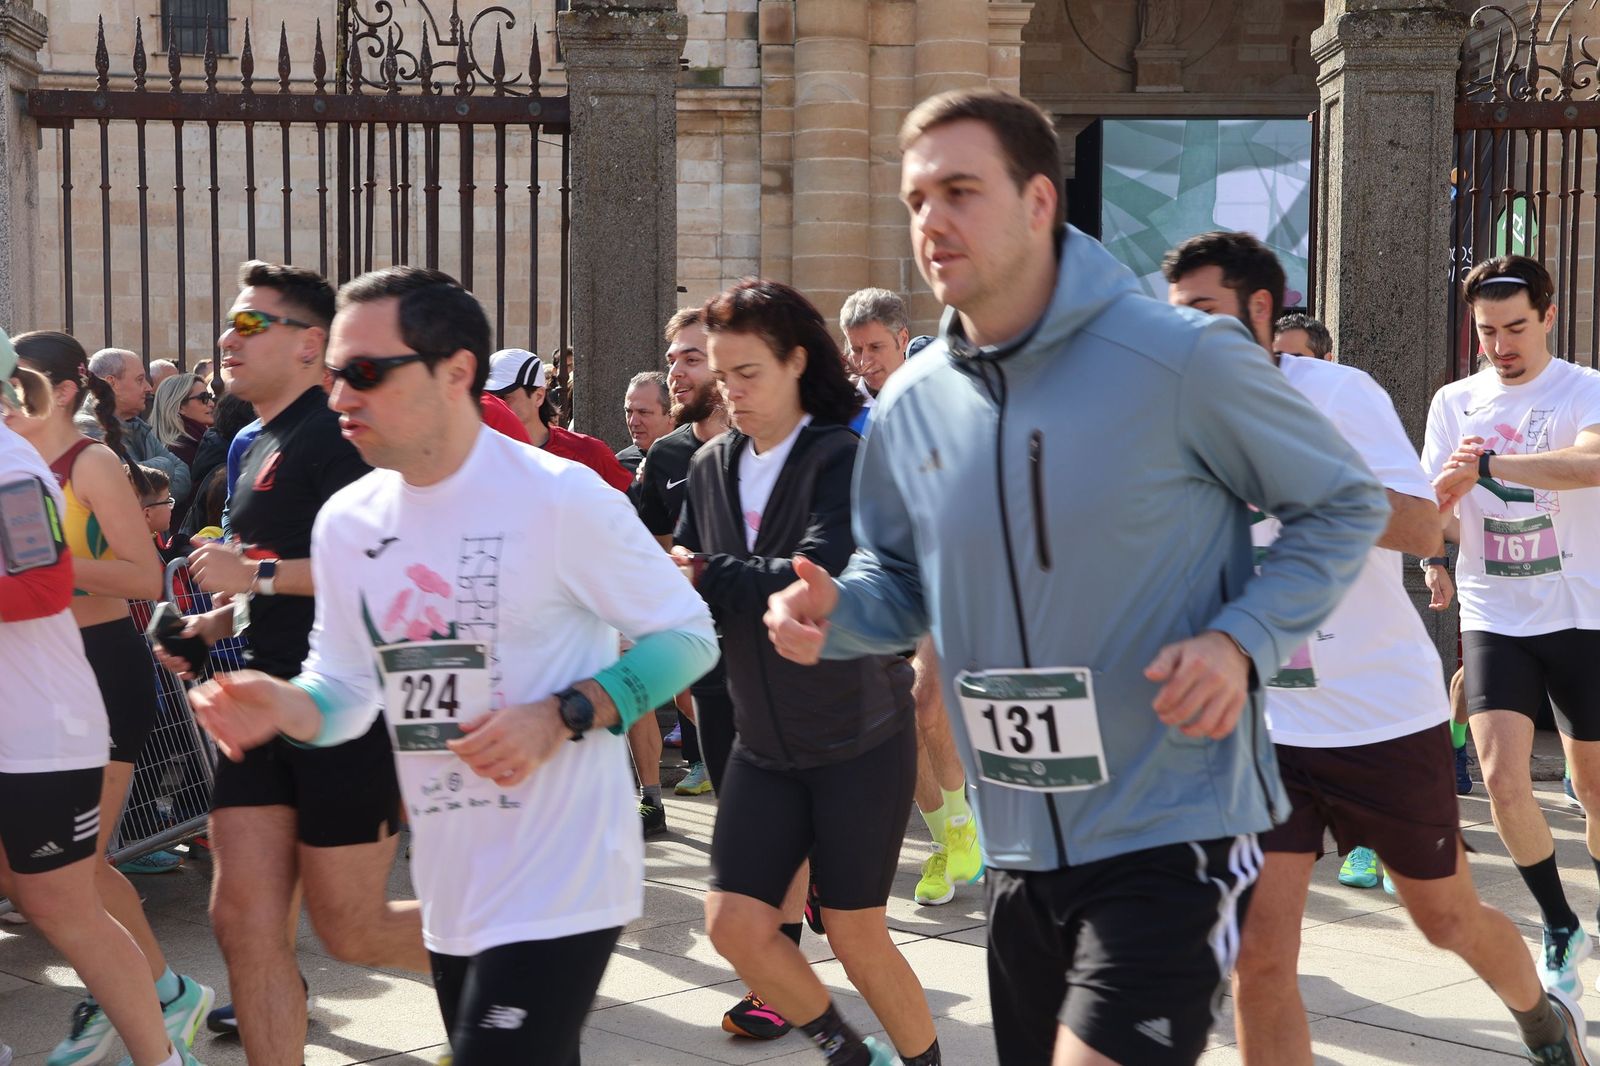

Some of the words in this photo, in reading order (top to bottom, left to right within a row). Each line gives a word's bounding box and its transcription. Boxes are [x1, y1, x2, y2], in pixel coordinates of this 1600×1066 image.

[1493, 533, 1541, 562] 767
[401, 673, 461, 719] 224
[981, 703, 1062, 754] 131
